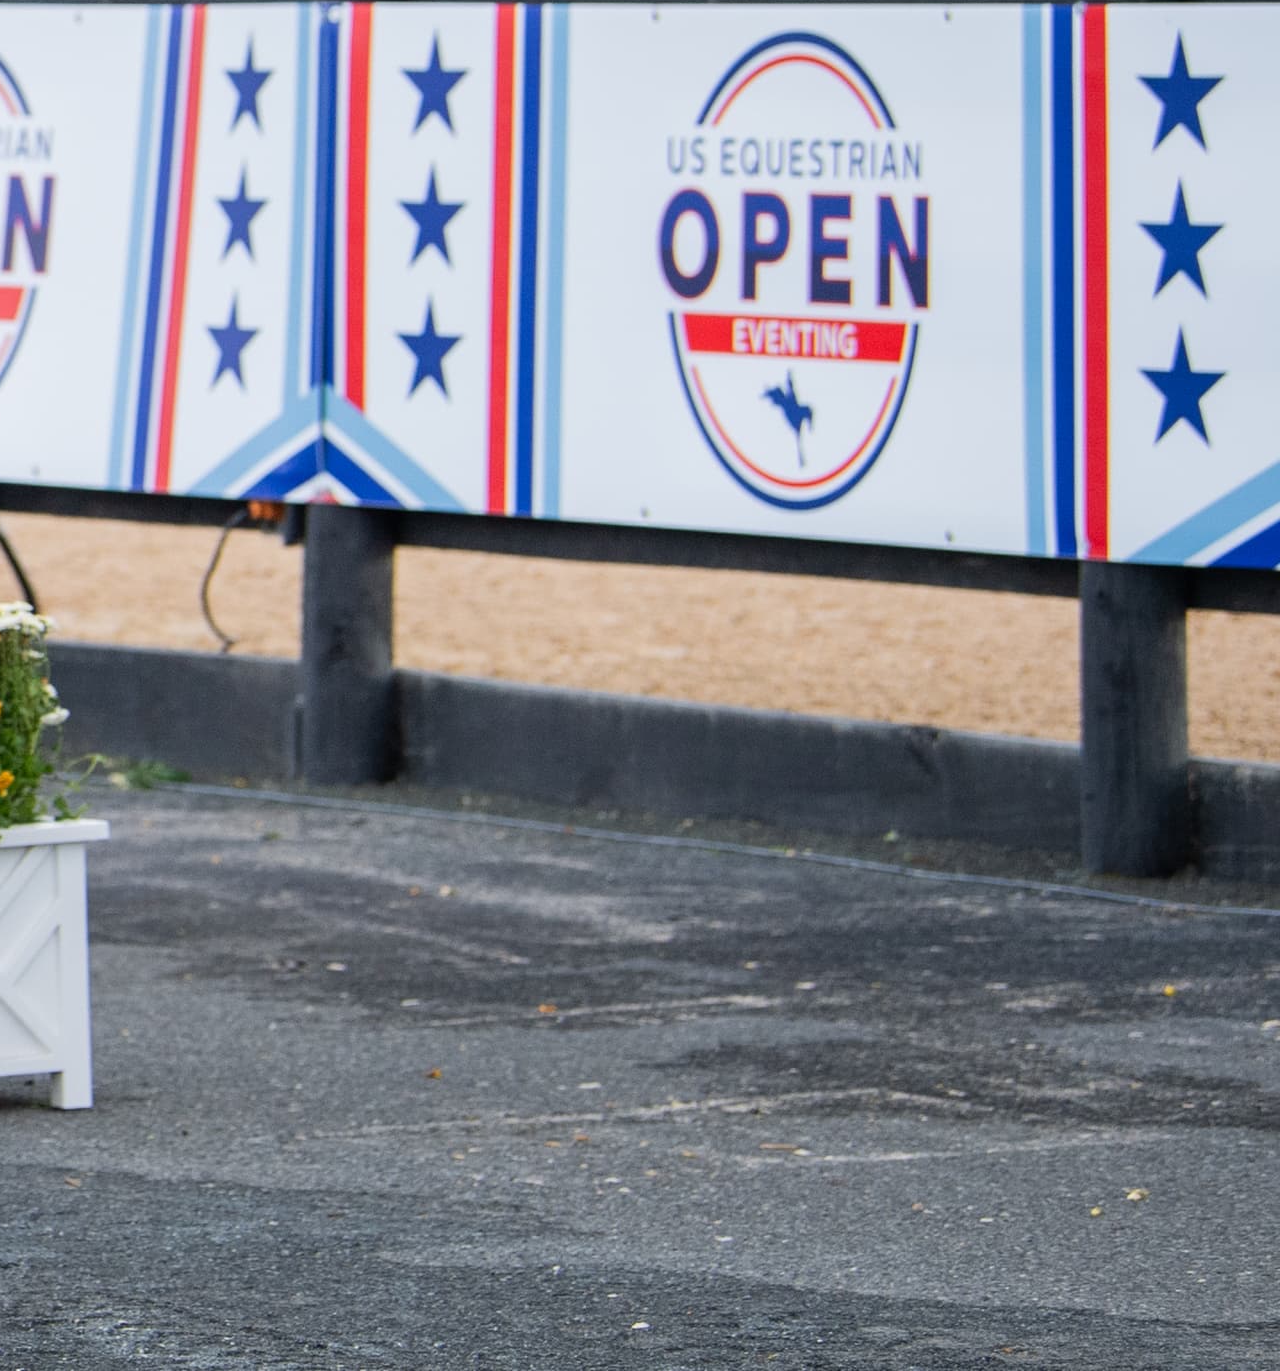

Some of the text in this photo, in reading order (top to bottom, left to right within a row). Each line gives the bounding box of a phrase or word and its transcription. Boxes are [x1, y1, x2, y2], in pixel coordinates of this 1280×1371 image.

[666, 136, 922, 178] US EQUESTRIAN
[658, 187, 930, 309] OPEN
[732, 318, 859, 358] EVENTING
